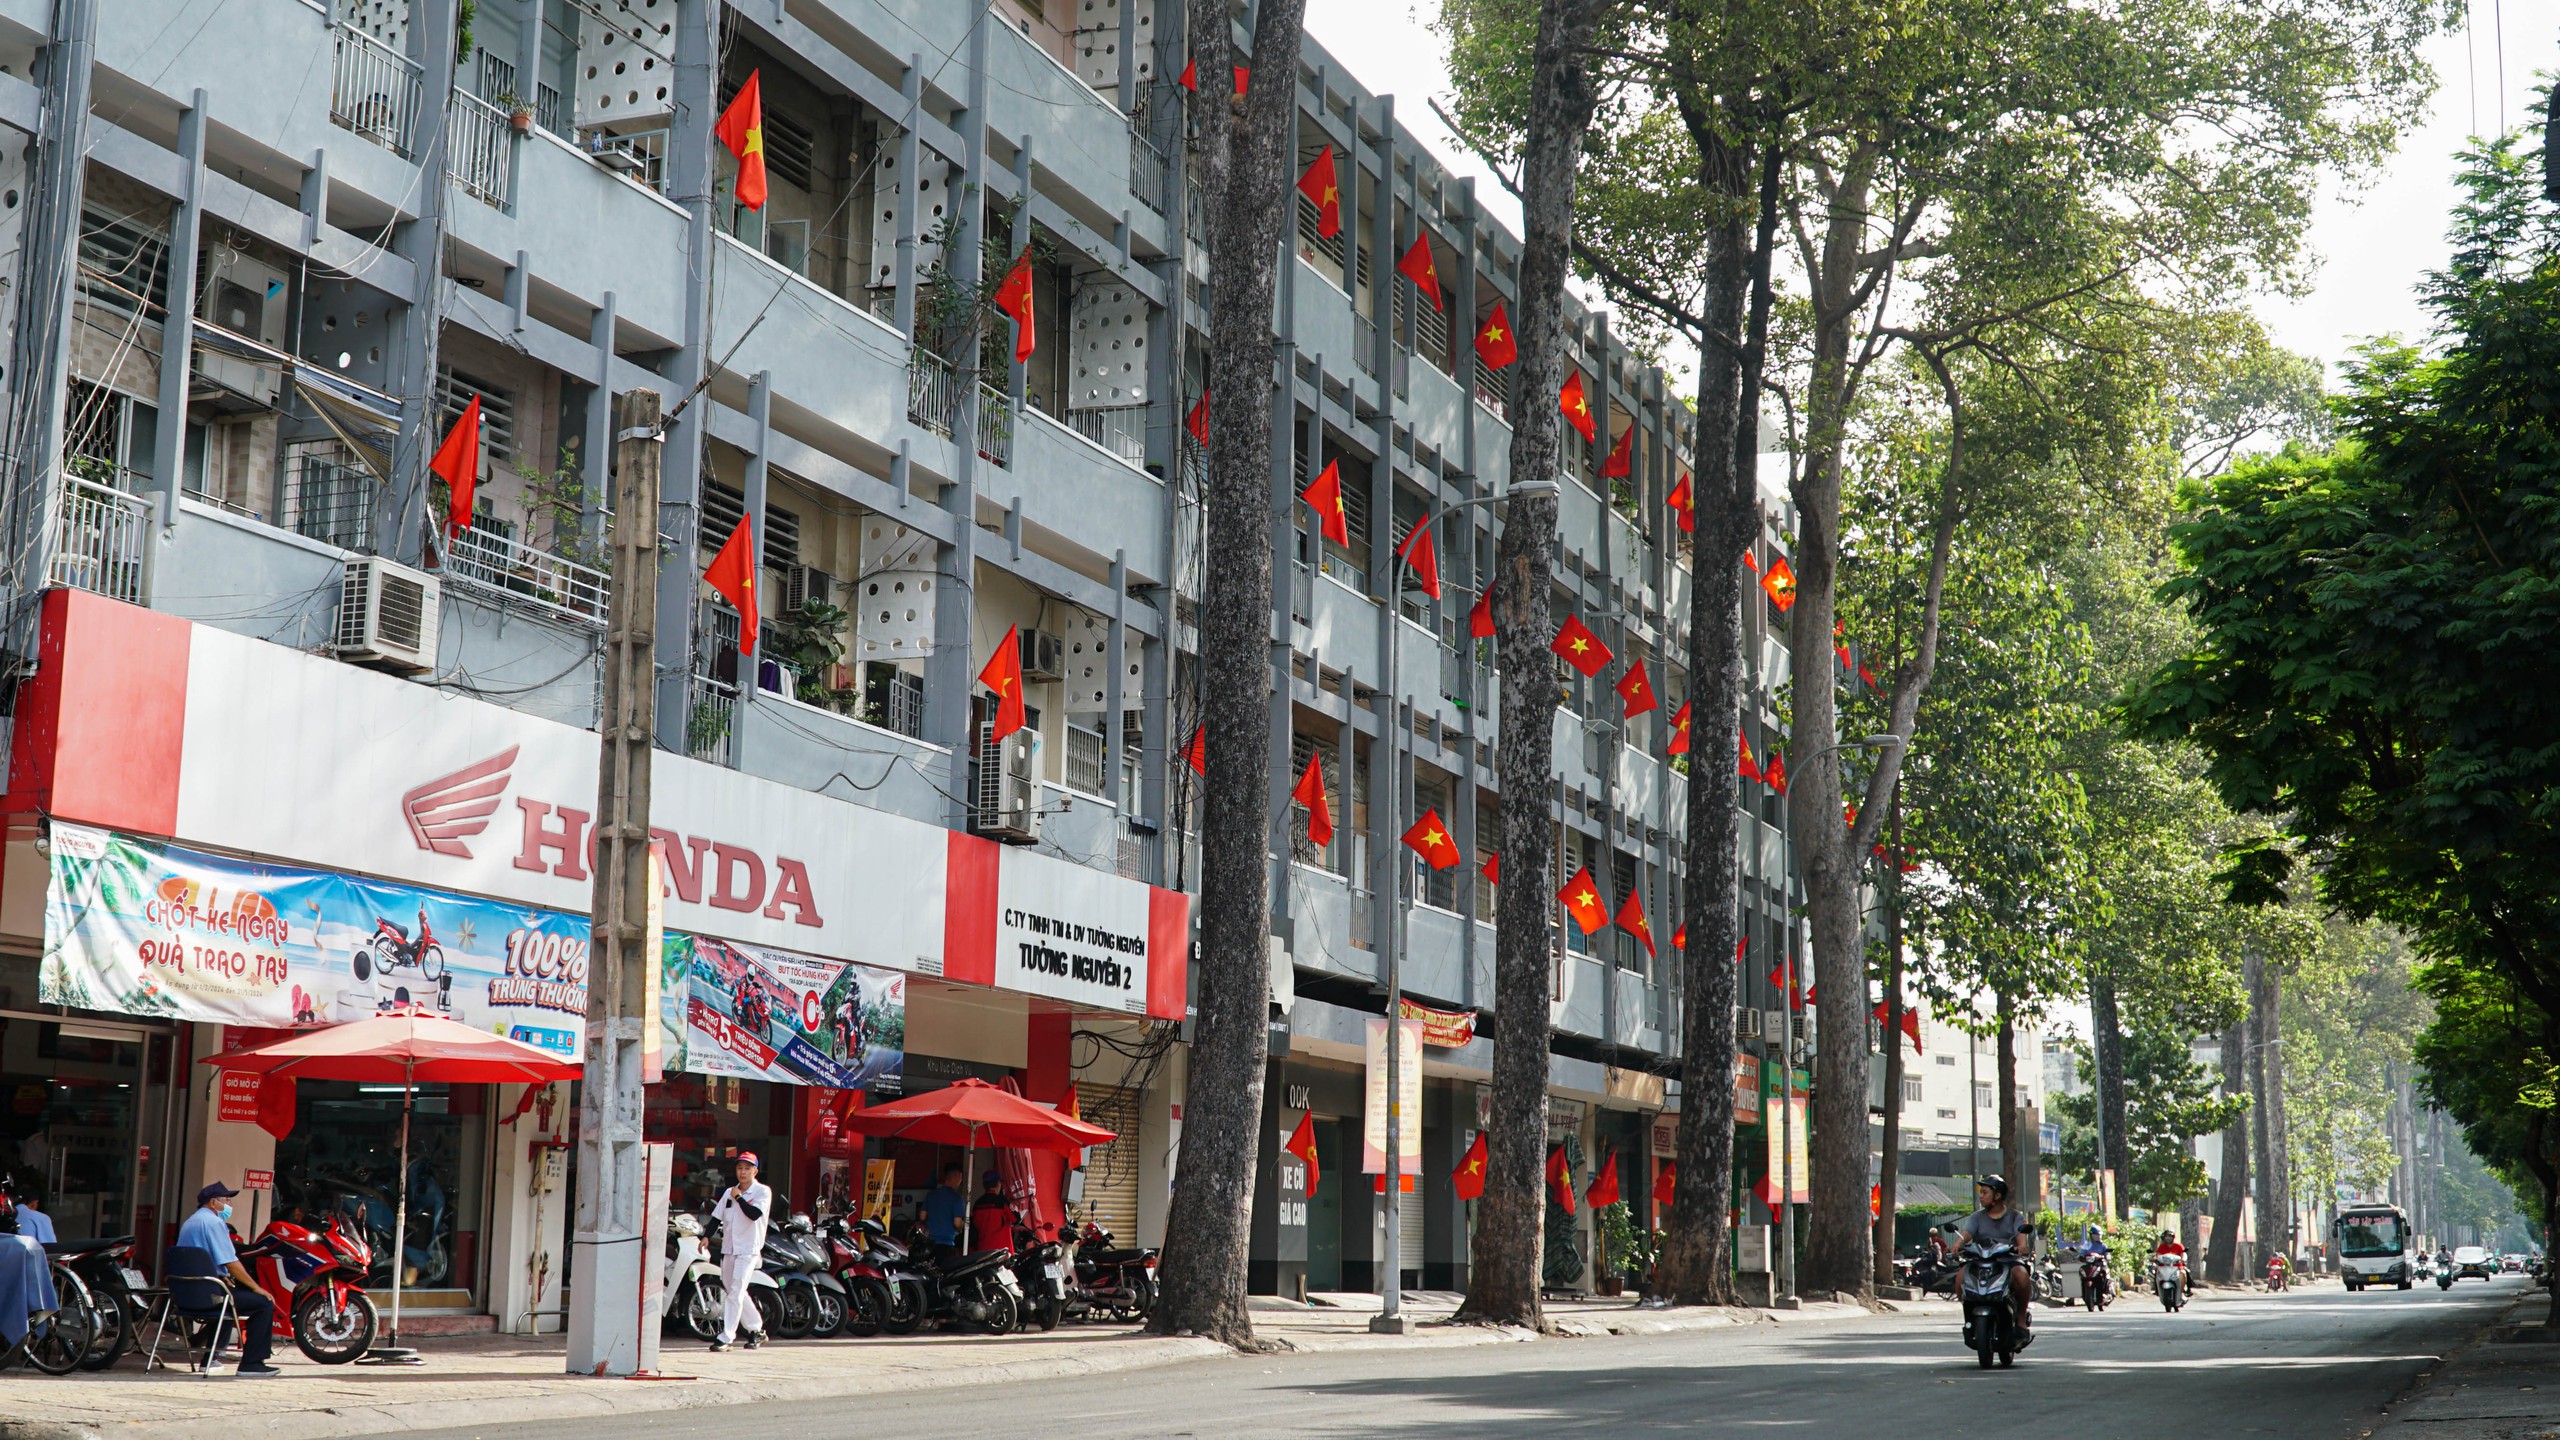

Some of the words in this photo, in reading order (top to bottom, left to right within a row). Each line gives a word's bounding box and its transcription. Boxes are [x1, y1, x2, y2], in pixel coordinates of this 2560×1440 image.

[514, 796, 823, 927] HNDA
[146, 889, 199, 931] CHỐT
[237, 913, 288, 947] NGAY
[1005, 908, 1026, 929] C.TY
[1028, 913, 1050, 935] TNHH
[1052, 919, 1064, 938] TM
[1065, 922, 1072, 940] &
[1073, 924, 1085, 943] DV
[1087, 926, 1115, 951] TƯỜNG
[1116, 936, 1145, 957] NGUYÊN
[138, 933, 185, 973] QUÀ
[193, 946, 246, 979] TRAO
[255, 954, 287, 985] TAY
[508, 928, 588, 983] 100%
[1019, 940, 1068, 977] TƯỜNG
[1071, 955, 1121, 990] NGUYÊN
[1123, 966, 1132, 990] 2
[491, 974, 536, 1003] TRÚNG
[719, 1015, 732, 1049] 5
[226, 1078, 239, 1088] GIỜ
[239, 1078, 251, 1089] MỞ
[1283, 1166, 1293, 1190] XE
[1293, 1163, 1304, 1190] CŨ
[1280, 1197, 1291, 1226] GIÁ
[1292, 1202, 1306, 1226] CAO
